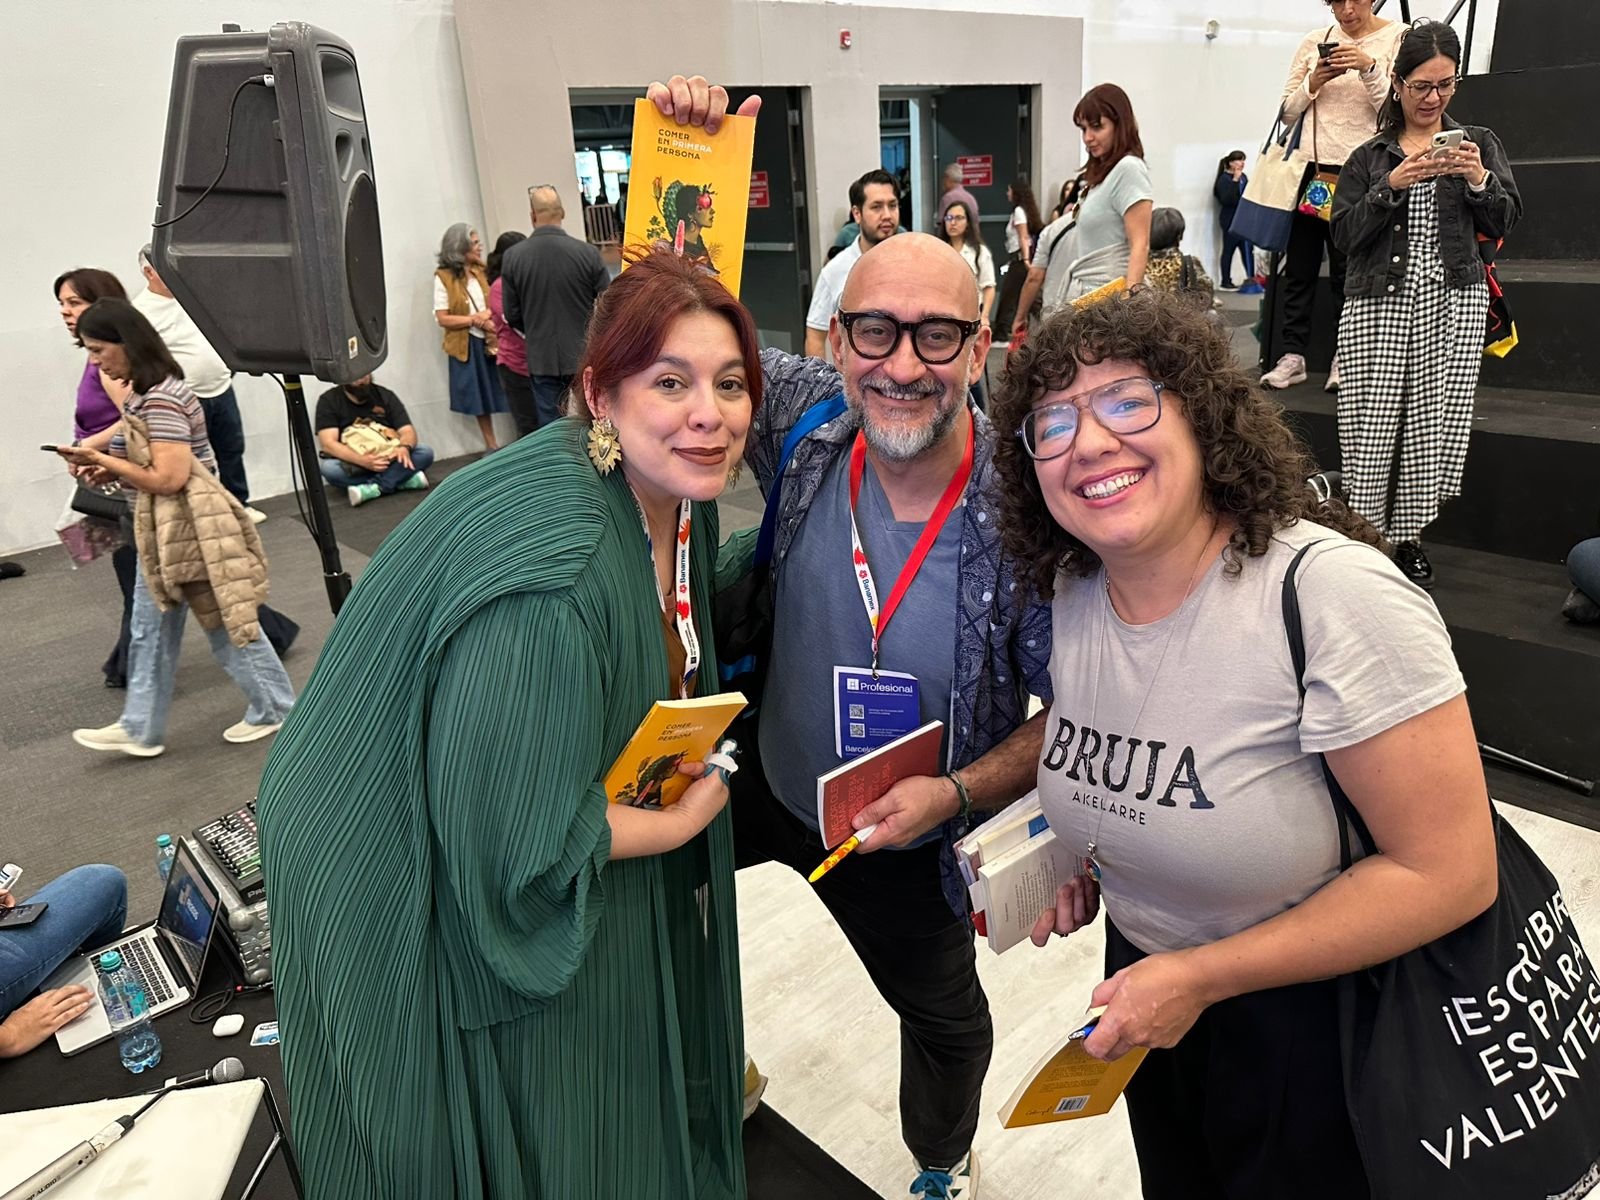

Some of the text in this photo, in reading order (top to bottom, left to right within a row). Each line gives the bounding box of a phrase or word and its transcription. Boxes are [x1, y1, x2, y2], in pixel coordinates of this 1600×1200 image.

[657, 136, 713, 153] EN PRIMERA
[658, 128, 690, 141] COMER
[656, 145, 701, 160] PERSONA
[679, 549, 687, 584] Banamex
[862, 578, 876, 611] Banamex
[860, 682, 913, 694] Profesional
[665, 721, 692, 730] COMER
[1042, 716, 1216, 810] BRUJA
[1072, 790, 1147, 826] AKELARRE
[1478, 934, 1585, 1087] ES PARA
